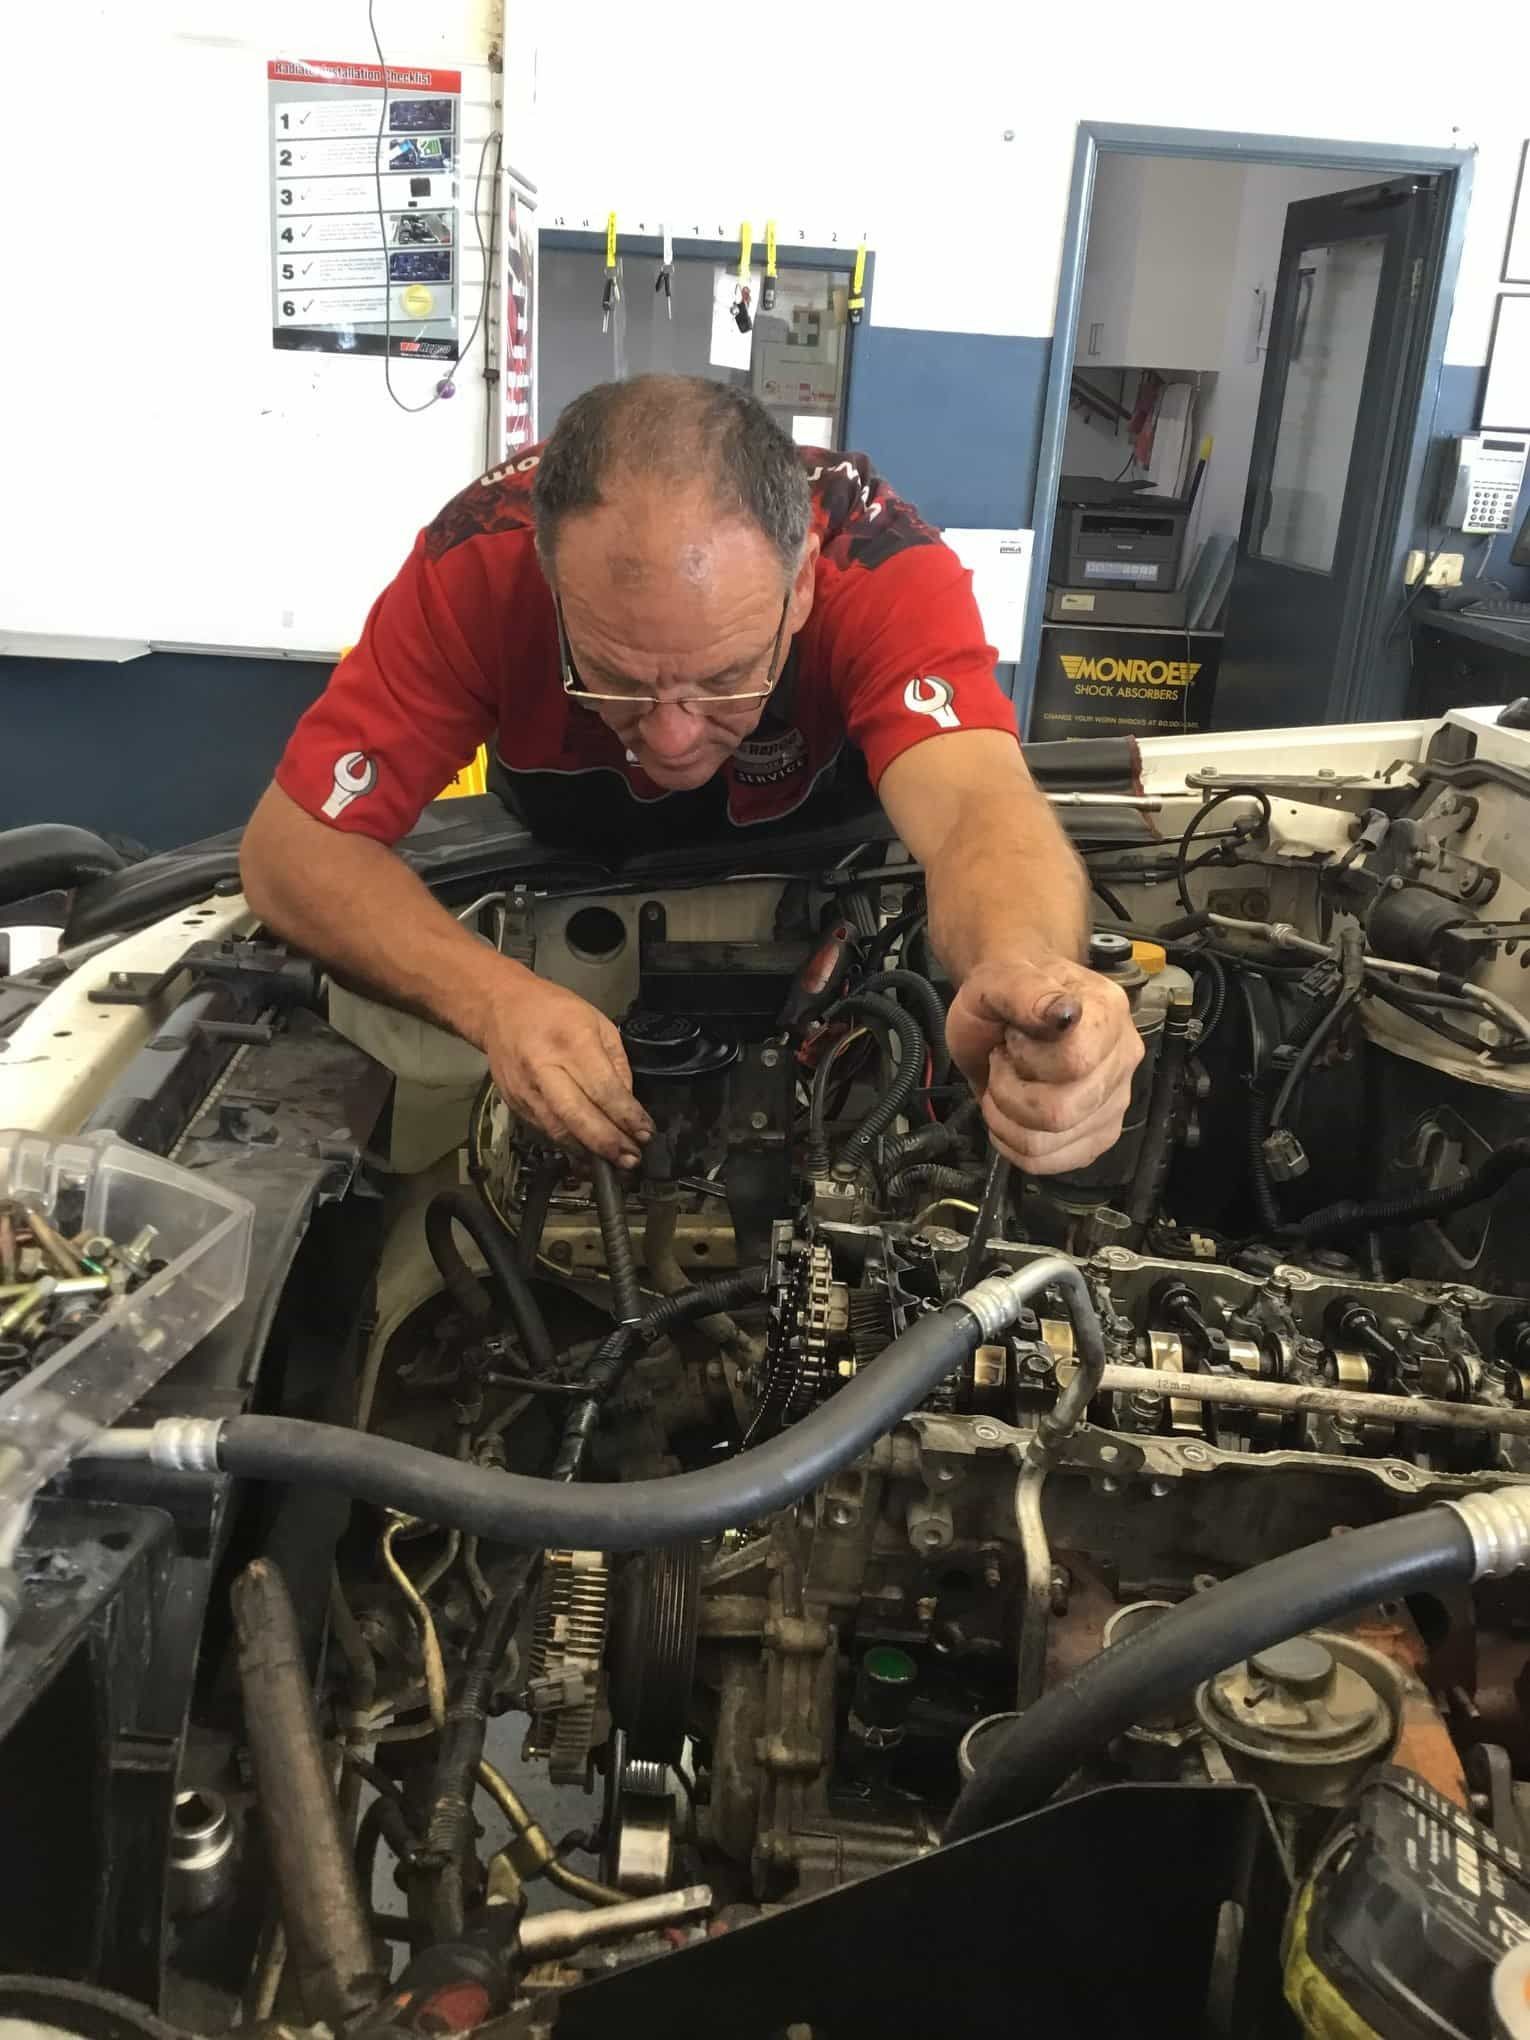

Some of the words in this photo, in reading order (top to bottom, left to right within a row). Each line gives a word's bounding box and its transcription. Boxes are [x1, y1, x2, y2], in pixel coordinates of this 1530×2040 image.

[275, 62, 318, 77] Radiat
[322, 67, 381, 81] stallation
[280, 114, 289, 129] 1
[280, 150, 292, 166] 2
[281, 189, 293, 205] 3
[281, 228, 294, 243] 4
[282, 264, 294, 280] 5
[283, 301, 295, 316] 6
[1070, 656, 1192, 686] MONROE
[1075, 684, 1114, 697] SHOCK
[1117, 687, 1179, 701] ABSORBERS
